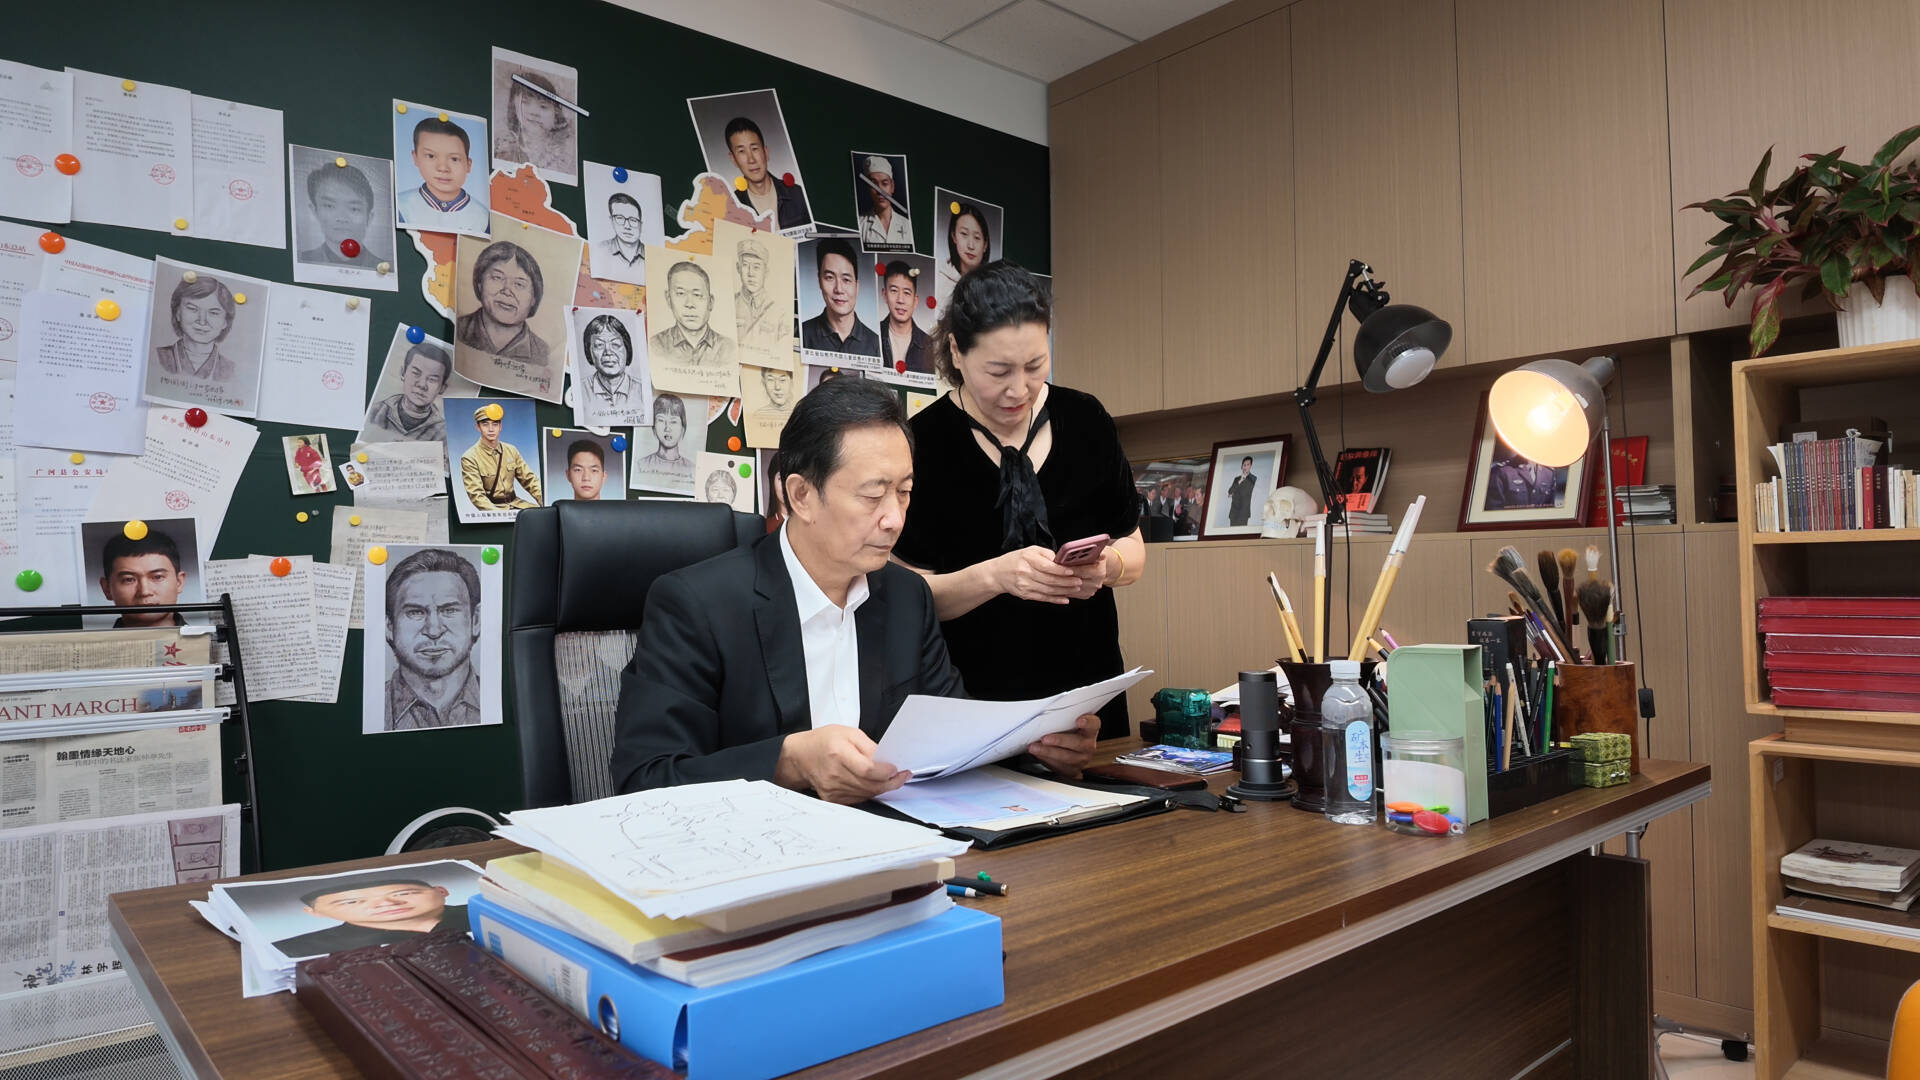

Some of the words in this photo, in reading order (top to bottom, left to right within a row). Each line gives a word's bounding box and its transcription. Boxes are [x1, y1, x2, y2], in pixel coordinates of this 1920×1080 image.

[52, 697, 138, 718] MARCH
[56, 745, 136, 761] 翰墨情缘天地心
